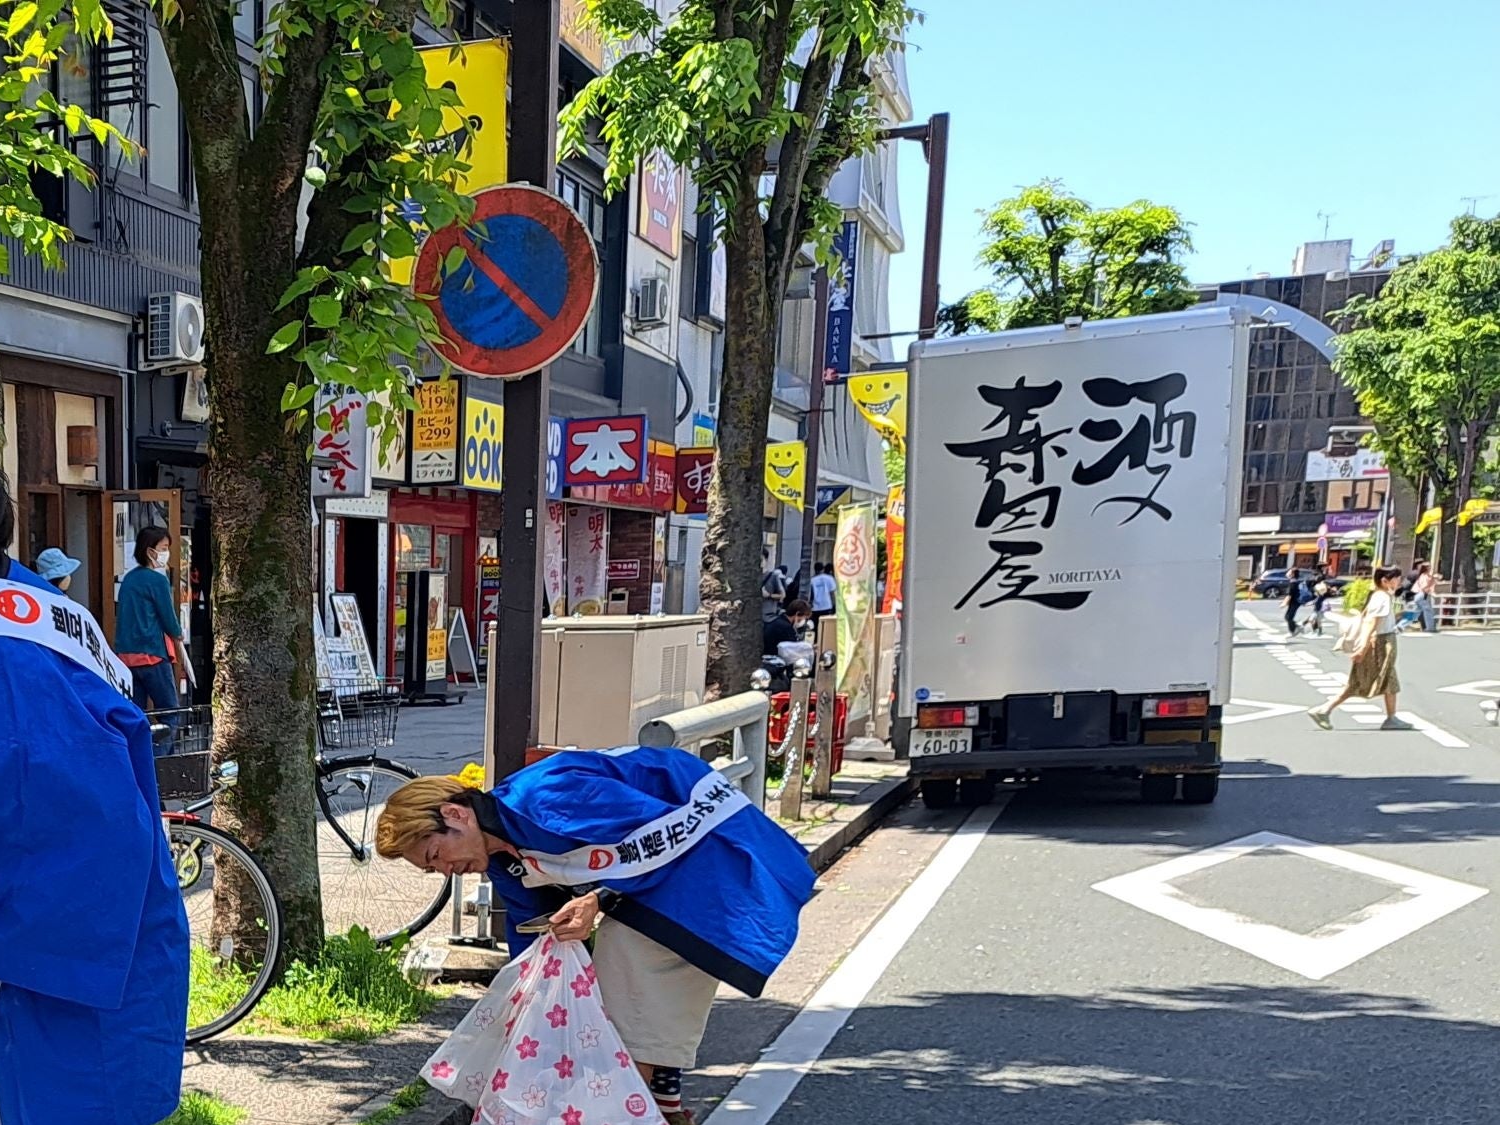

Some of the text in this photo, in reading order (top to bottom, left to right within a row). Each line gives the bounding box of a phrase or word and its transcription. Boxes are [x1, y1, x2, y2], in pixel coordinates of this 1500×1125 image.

[830, 317, 841, 363] BANYA
[417, 415, 455, 430] 生ビール
[569, 423, 637, 478] 本
[943, 374, 1093, 612] 森田屋
[1047, 567, 1123, 585] MORITAYA
